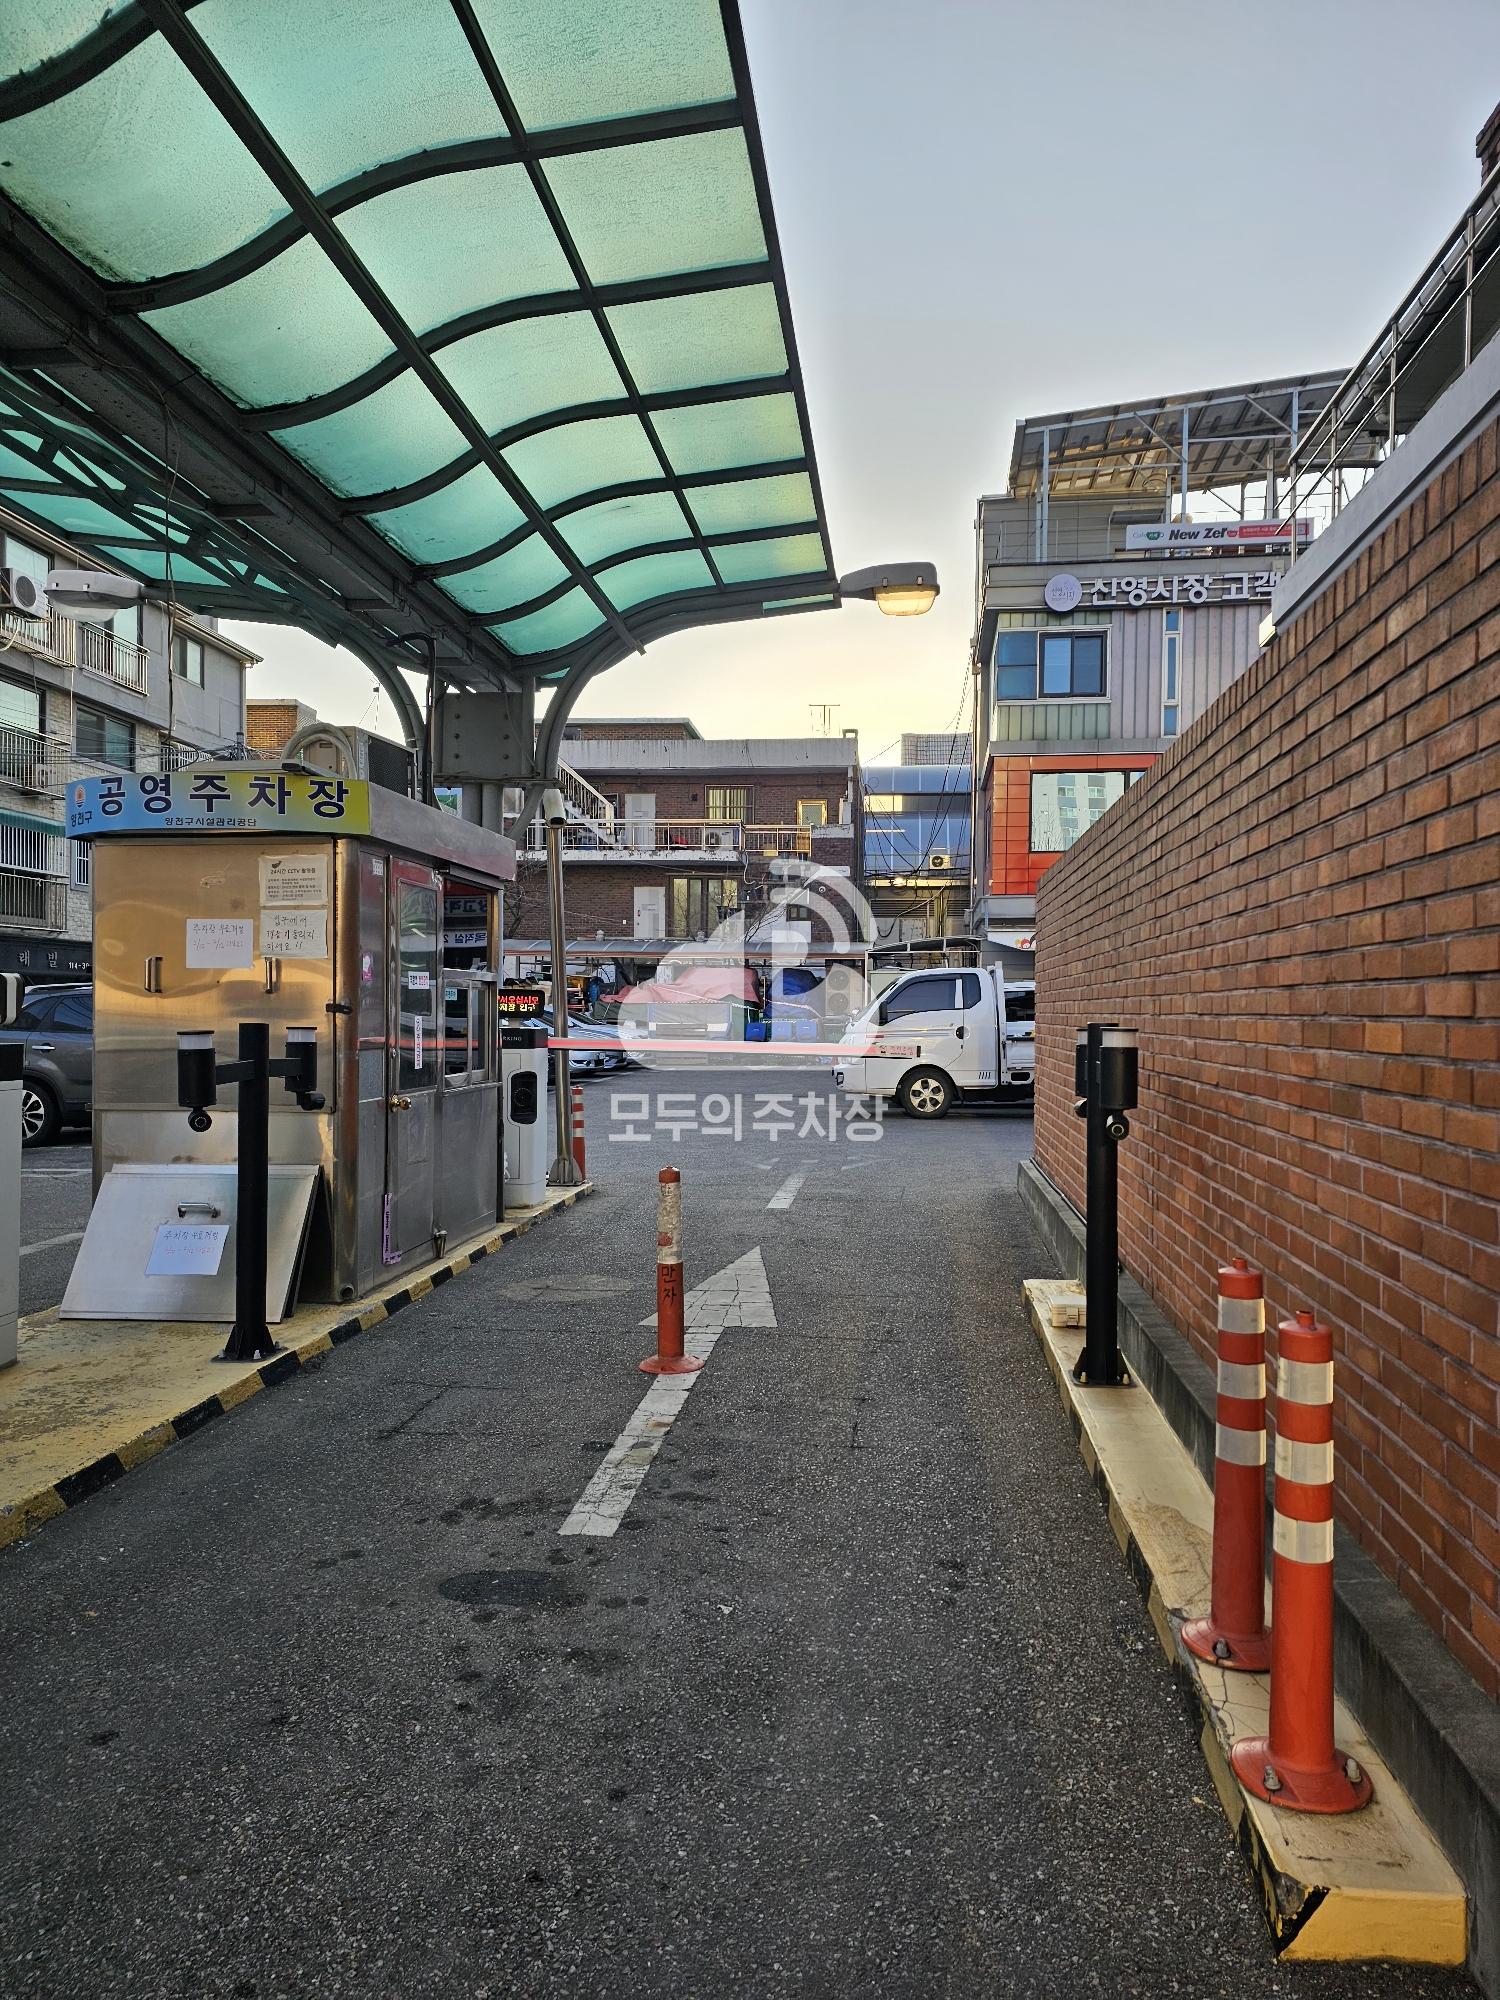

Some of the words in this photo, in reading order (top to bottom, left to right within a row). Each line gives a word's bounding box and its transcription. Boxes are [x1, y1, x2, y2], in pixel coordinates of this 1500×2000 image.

[1169, 529, 1200, 541] New
[1090, 574, 1213, 606] 신영시장
[70, 811, 93, 828] 양천구
[164, 816, 257, 828] 양천구시설관리공단
[498, 1003, 516, 1012] 차장
